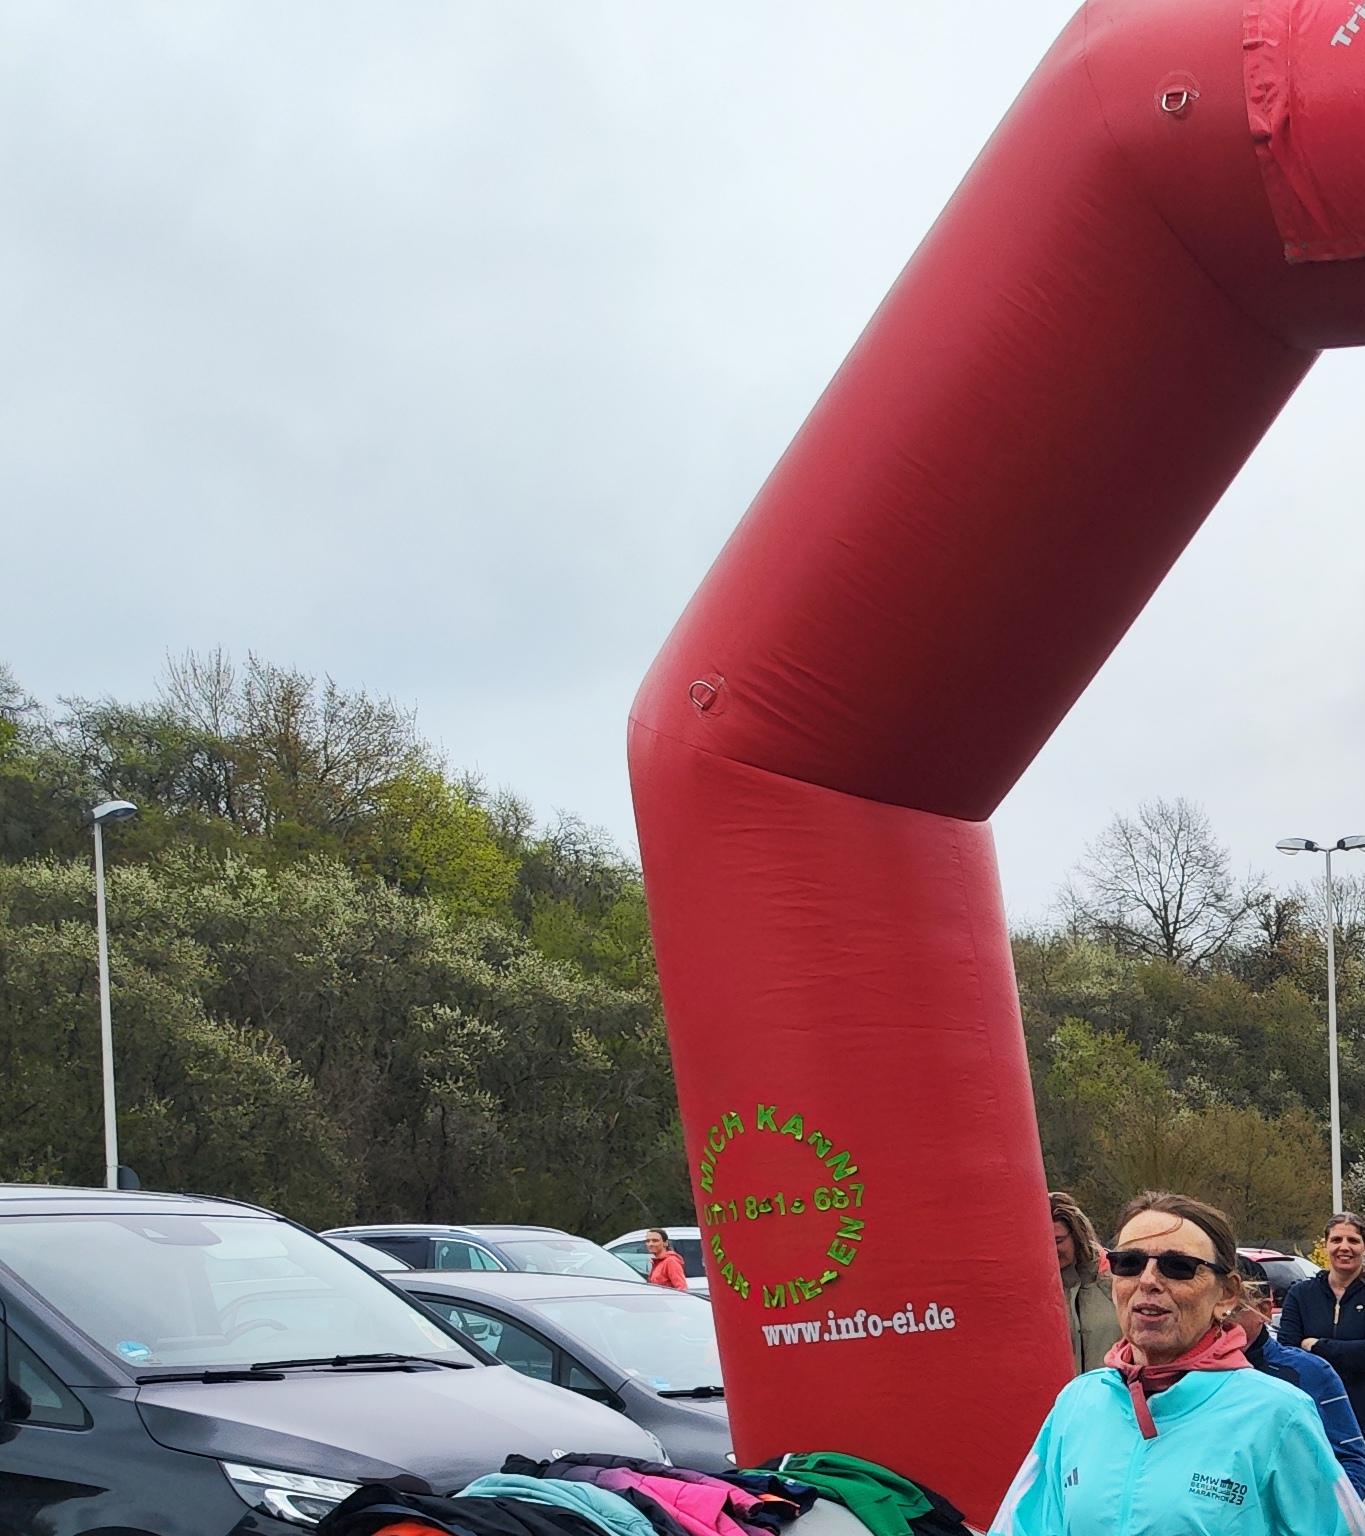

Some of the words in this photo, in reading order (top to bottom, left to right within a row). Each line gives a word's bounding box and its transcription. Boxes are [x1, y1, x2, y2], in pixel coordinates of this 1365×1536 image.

[700, 1111, 745, 1193] MICH
[757, 1103, 858, 1182] KANN
[762, 1302, 956, 1347] www.info-ei.de
[1190, 1481, 1218, 1492] BERLIN
[1192, 1472, 1220, 1486] BMW
[1232, 1483, 1248, 1495] 20
[1229, 1493, 1245, 1506] 23
